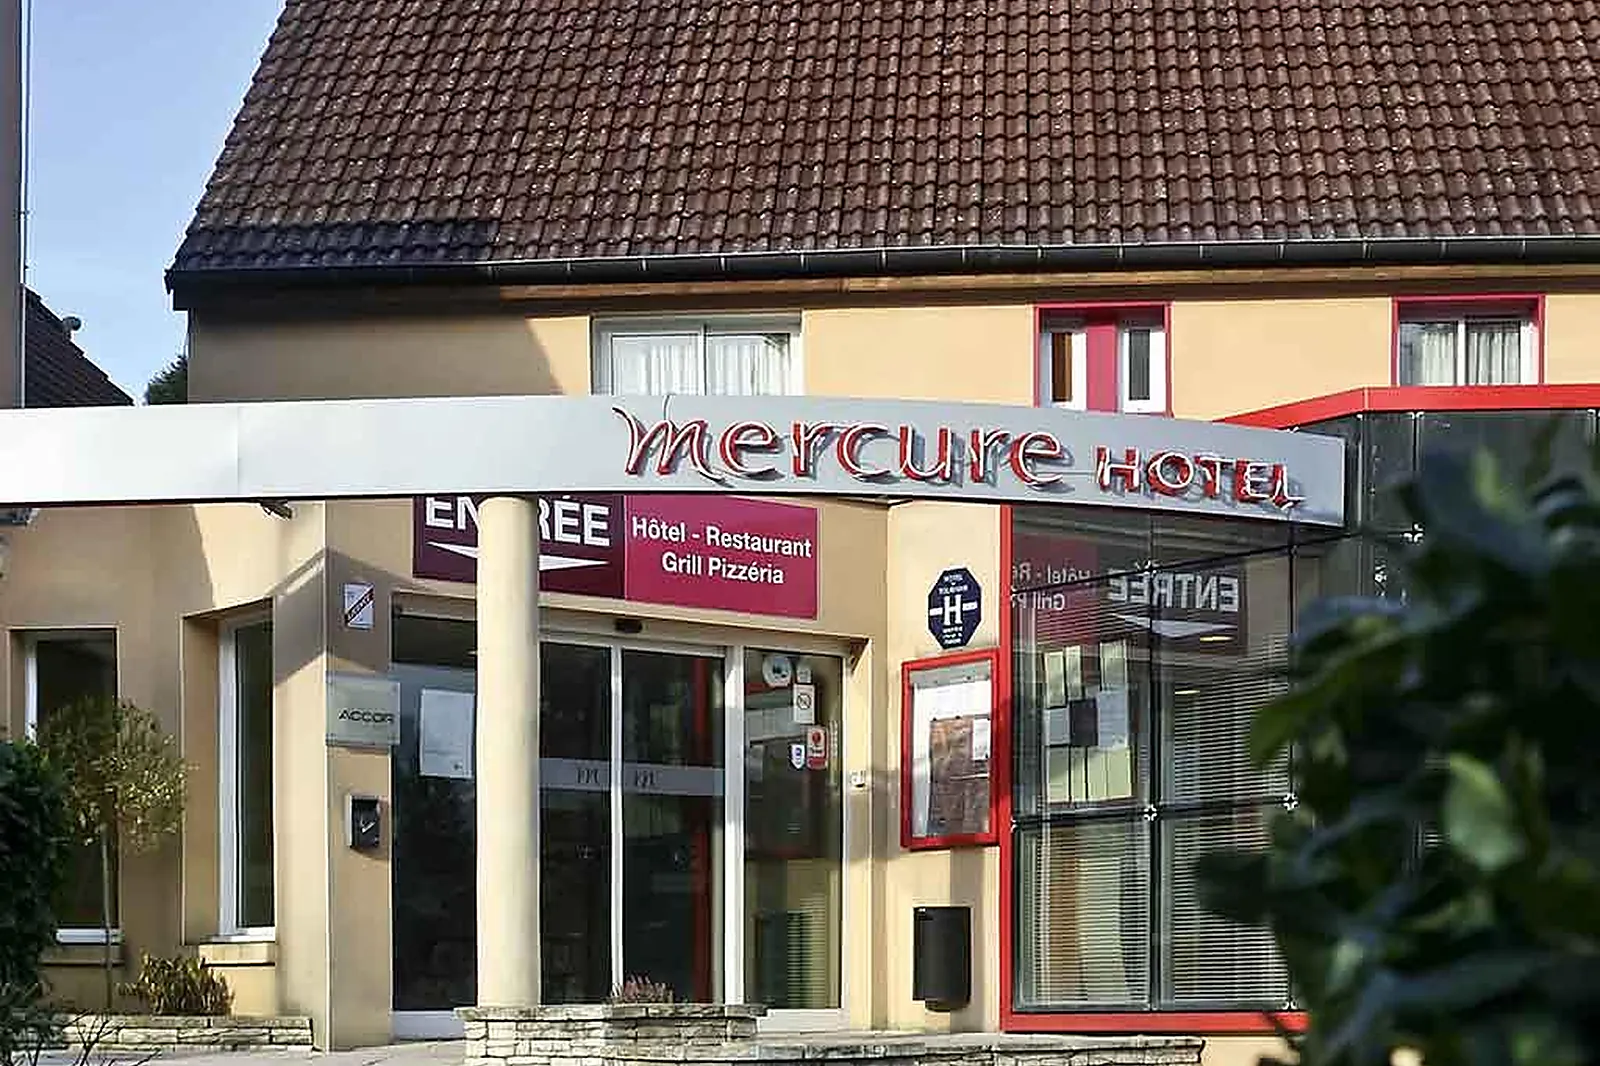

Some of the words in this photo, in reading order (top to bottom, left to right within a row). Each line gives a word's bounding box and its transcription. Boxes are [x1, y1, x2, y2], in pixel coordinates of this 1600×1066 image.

[1095, 445, 1305, 510] HOTEL
[632, 516, 685, 543] Hôtel
[706, 525, 812, 558] Restaurant
[662, 551, 701, 575] Grill
[708, 557, 784, 584] Pizzéria
[943, 593, 963, 626] H
[338, 709, 395, 724] ACCOR
